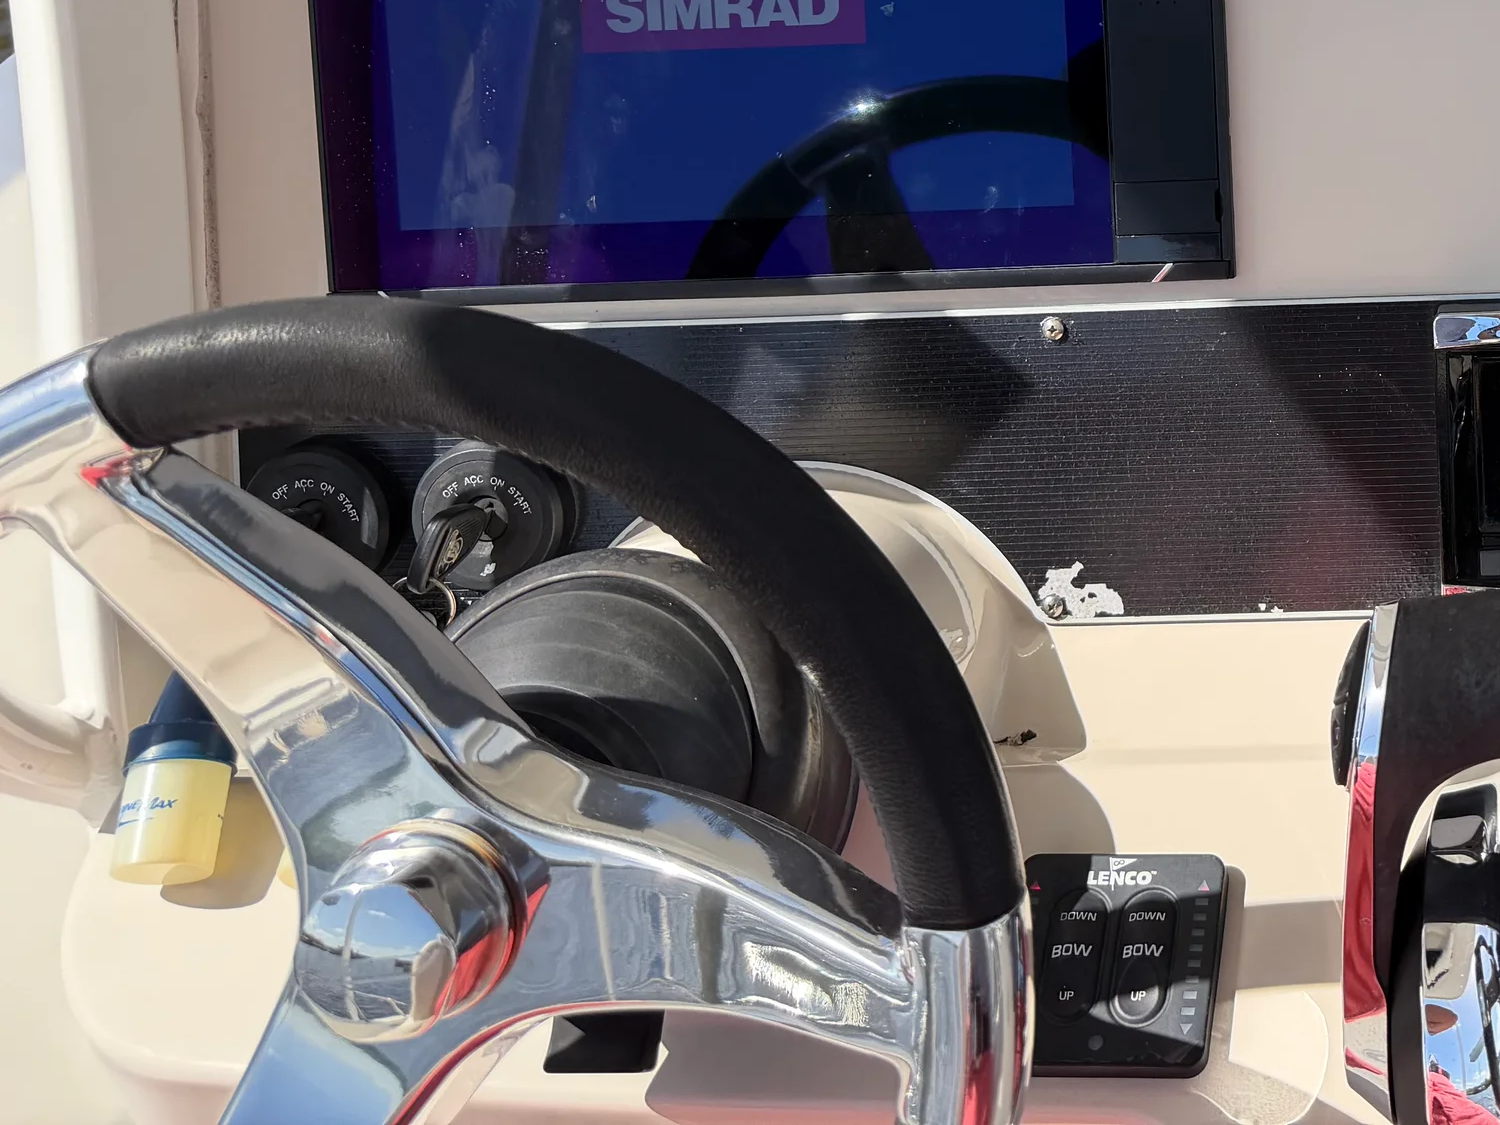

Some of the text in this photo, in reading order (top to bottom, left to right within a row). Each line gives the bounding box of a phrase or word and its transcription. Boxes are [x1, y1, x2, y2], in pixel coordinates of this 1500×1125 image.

[271, 478, 360, 523] OFF ACC ON START
[442, 474, 532, 516] OFF ACC ON START
[1087, 870, 1155, 887] LENCO
[1060, 911, 1097, 922] DOWN
[1128, 911, 1166, 922] DOWN
[1051, 943, 1093, 958] BOW
[1122, 943, 1164, 958] BOW
[1059, 990, 1074, 1001] UP
[1130, 990, 1146, 1001] UP
